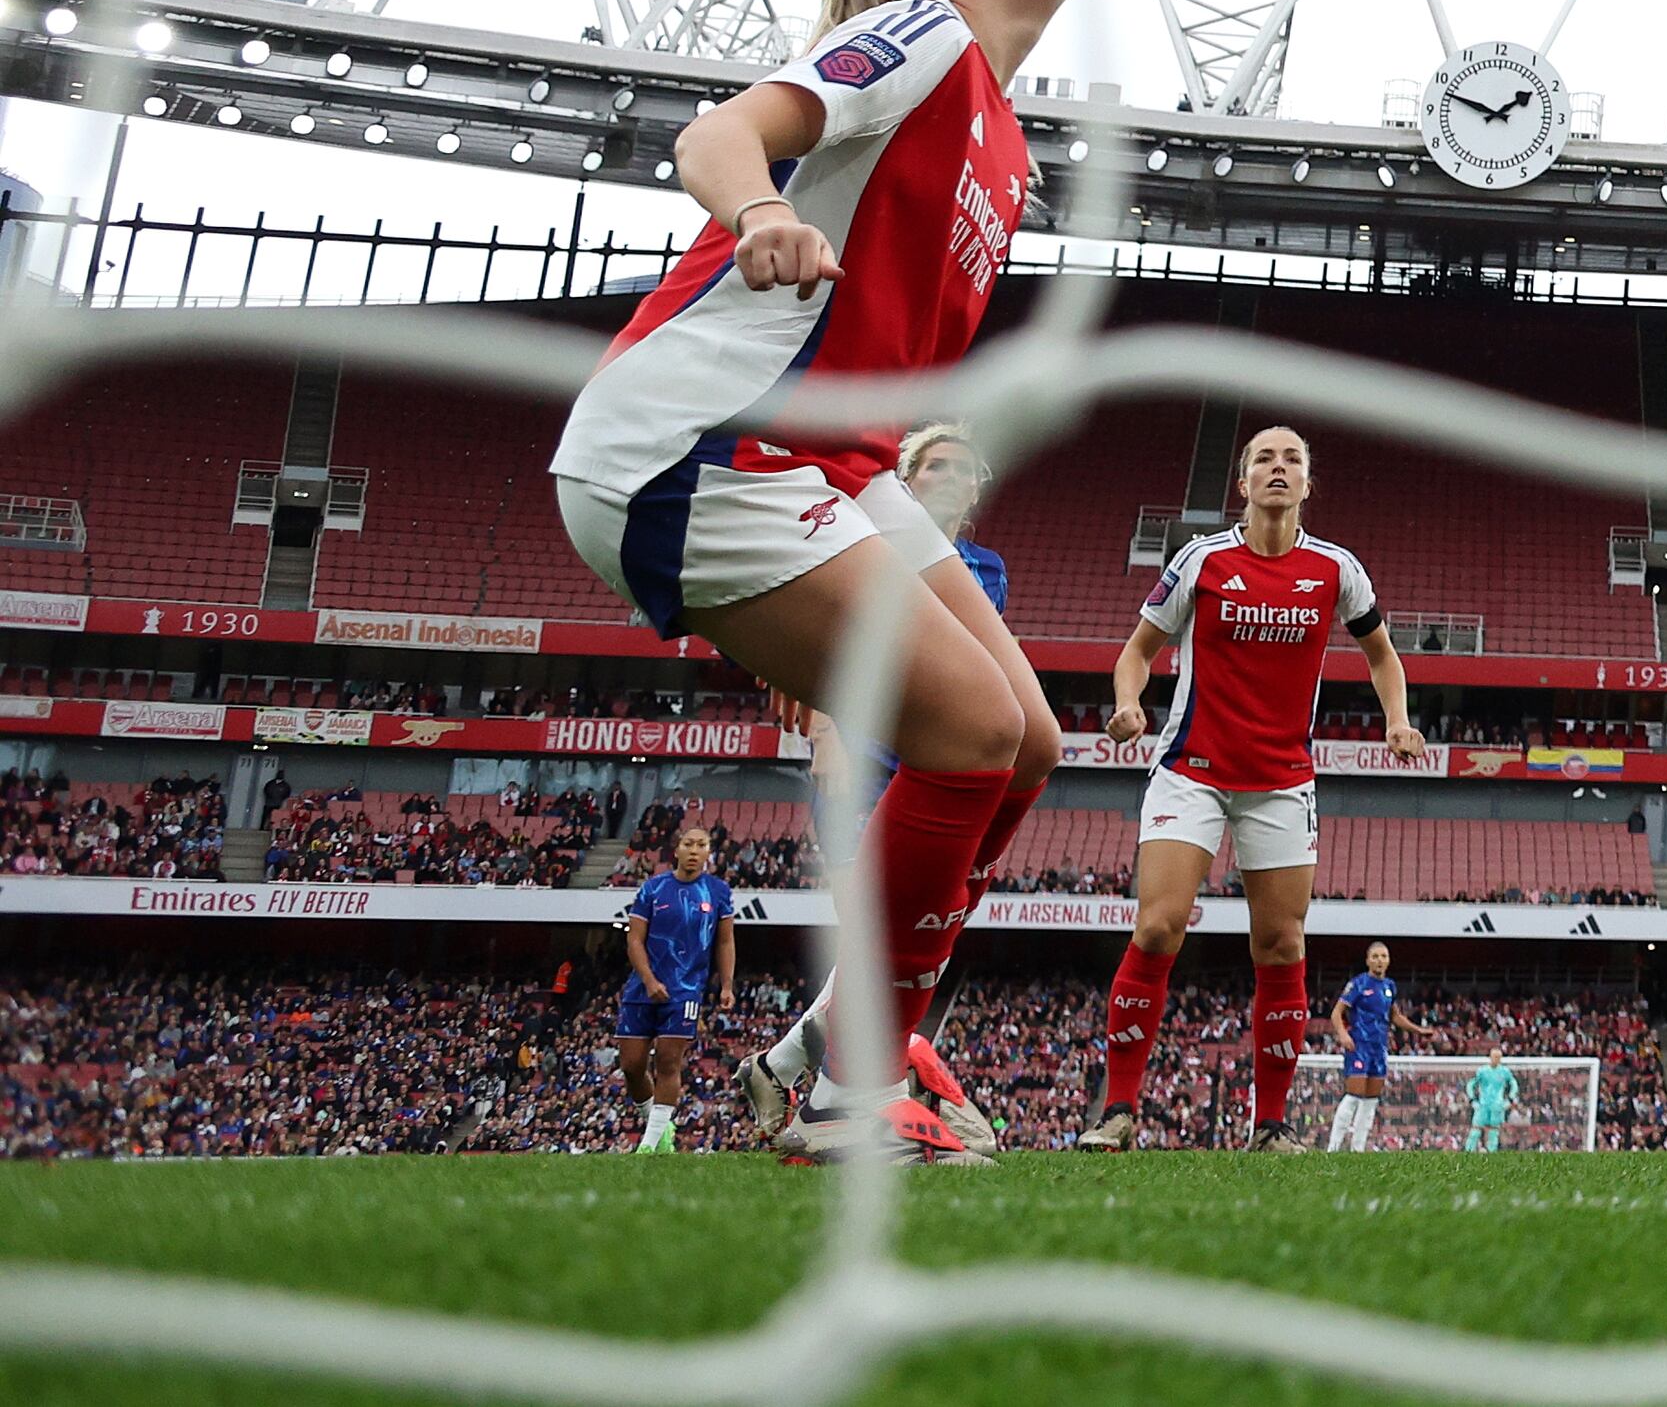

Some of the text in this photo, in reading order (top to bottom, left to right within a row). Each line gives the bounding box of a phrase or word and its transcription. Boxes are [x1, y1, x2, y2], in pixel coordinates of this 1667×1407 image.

[1462, 50, 1473, 62] 11
[1495, 44, 1508, 56] 12
[1435, 71, 1448, 84] 10
[1552, 80, 1559, 92] 2
[1426, 104, 1434, 115] 9
[1558, 113, 1565, 125] 3
[1432, 137, 1439, 149] 8
[1545, 145, 1553, 156] 4
[1454, 162, 1461, 173] 7
[1520, 166, 1527, 178] 5
[1485, 173, 1493, 185] 6
[954, 159, 1009, 262] Emirate
[949, 215, 970, 254] FLY
[1, 594, 84, 619] Arsenal
[1220, 600, 1320, 625] Emirates
[182, 611, 259, 635] 1930
[320, 615, 412, 642] Arsenal
[1233, 625, 1306, 643] FLY BETTER
[135, 705, 223, 728] Arsenal
[557, 720, 634, 751] HONG
[666, 724, 740, 754] KONG
[1094, 738, 1155, 764] Slov
[968, 856, 1002, 880] AF
[130, 886, 370, 914] Emirates FLY BETTER
[914, 906, 967, 930] AF
[989, 902, 1138, 924] MY ARSENAL REW
[1114, 994, 1151, 1009] AFC
[1265, 1009, 1304, 1021] AFC
